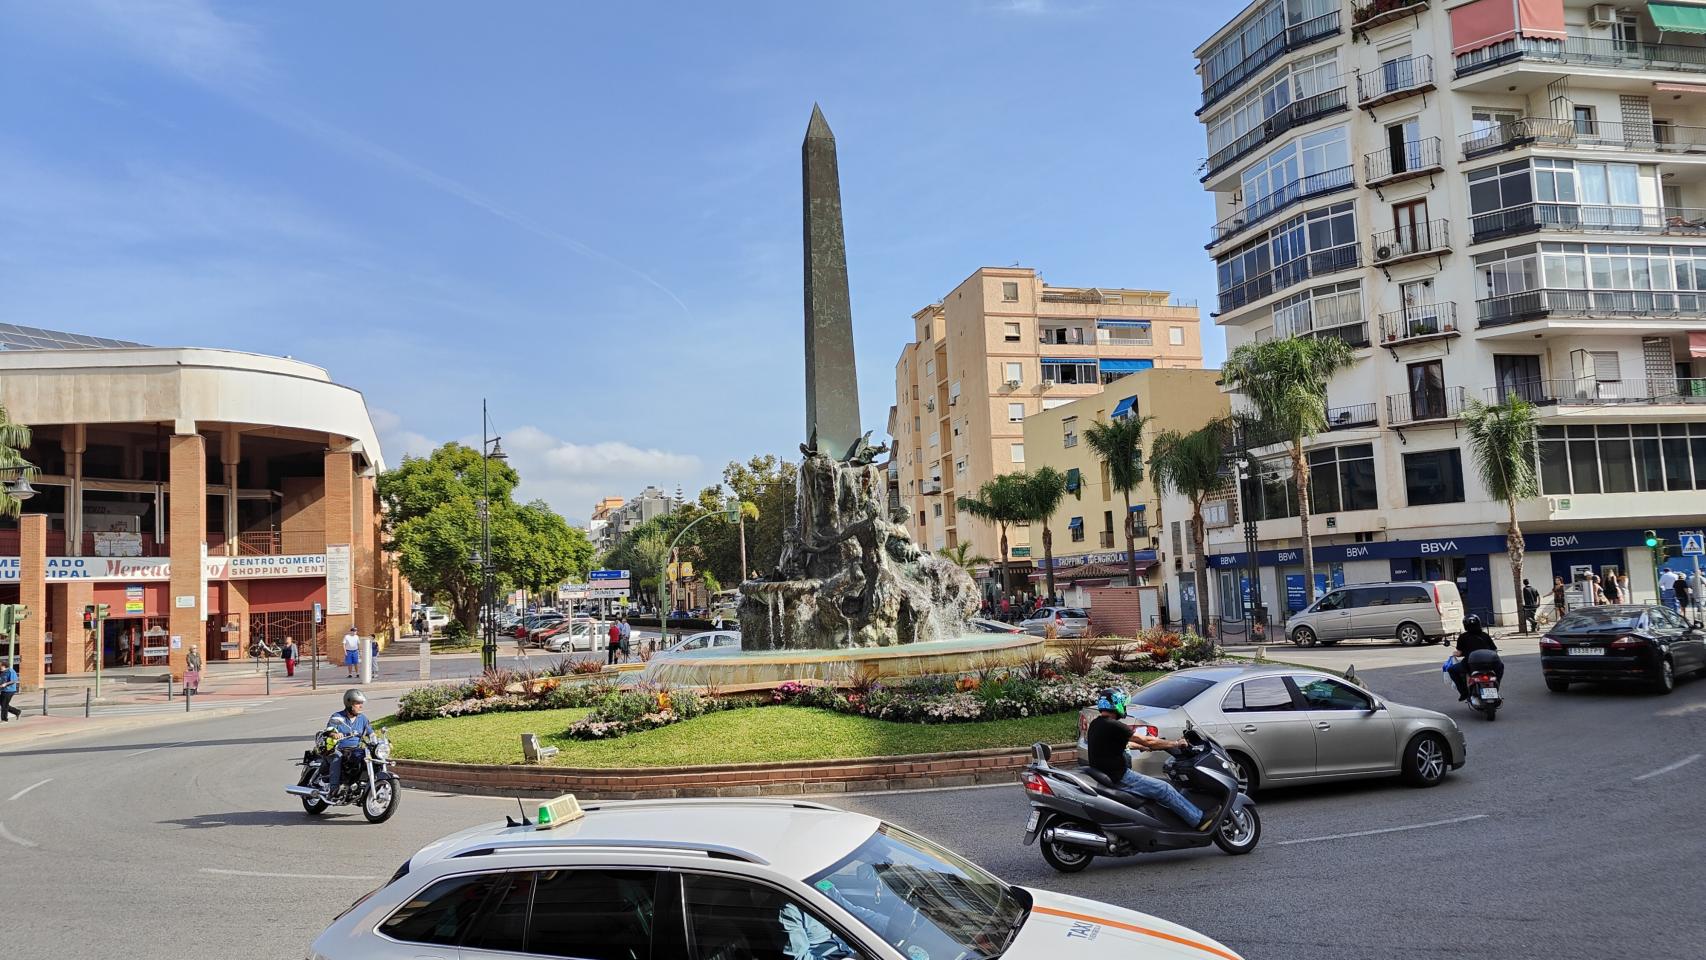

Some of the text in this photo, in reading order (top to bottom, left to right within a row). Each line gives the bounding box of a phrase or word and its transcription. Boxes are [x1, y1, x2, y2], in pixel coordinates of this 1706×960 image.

[1420, 541, 1458, 553] BBVA
[1550, 536, 1579, 547] BBVA
[1277, 552, 1297, 562] BBVA
[1346, 546, 1369, 557] BBVA
[0, 559, 84, 567] MEADO
[232, 556, 325, 566] CENTRO COMERCI
[1220, 556, 1237, 565] BBVA
[231, 565, 325, 576] SHOPPING CENT
[1067, 921, 1093, 938] TAXI
